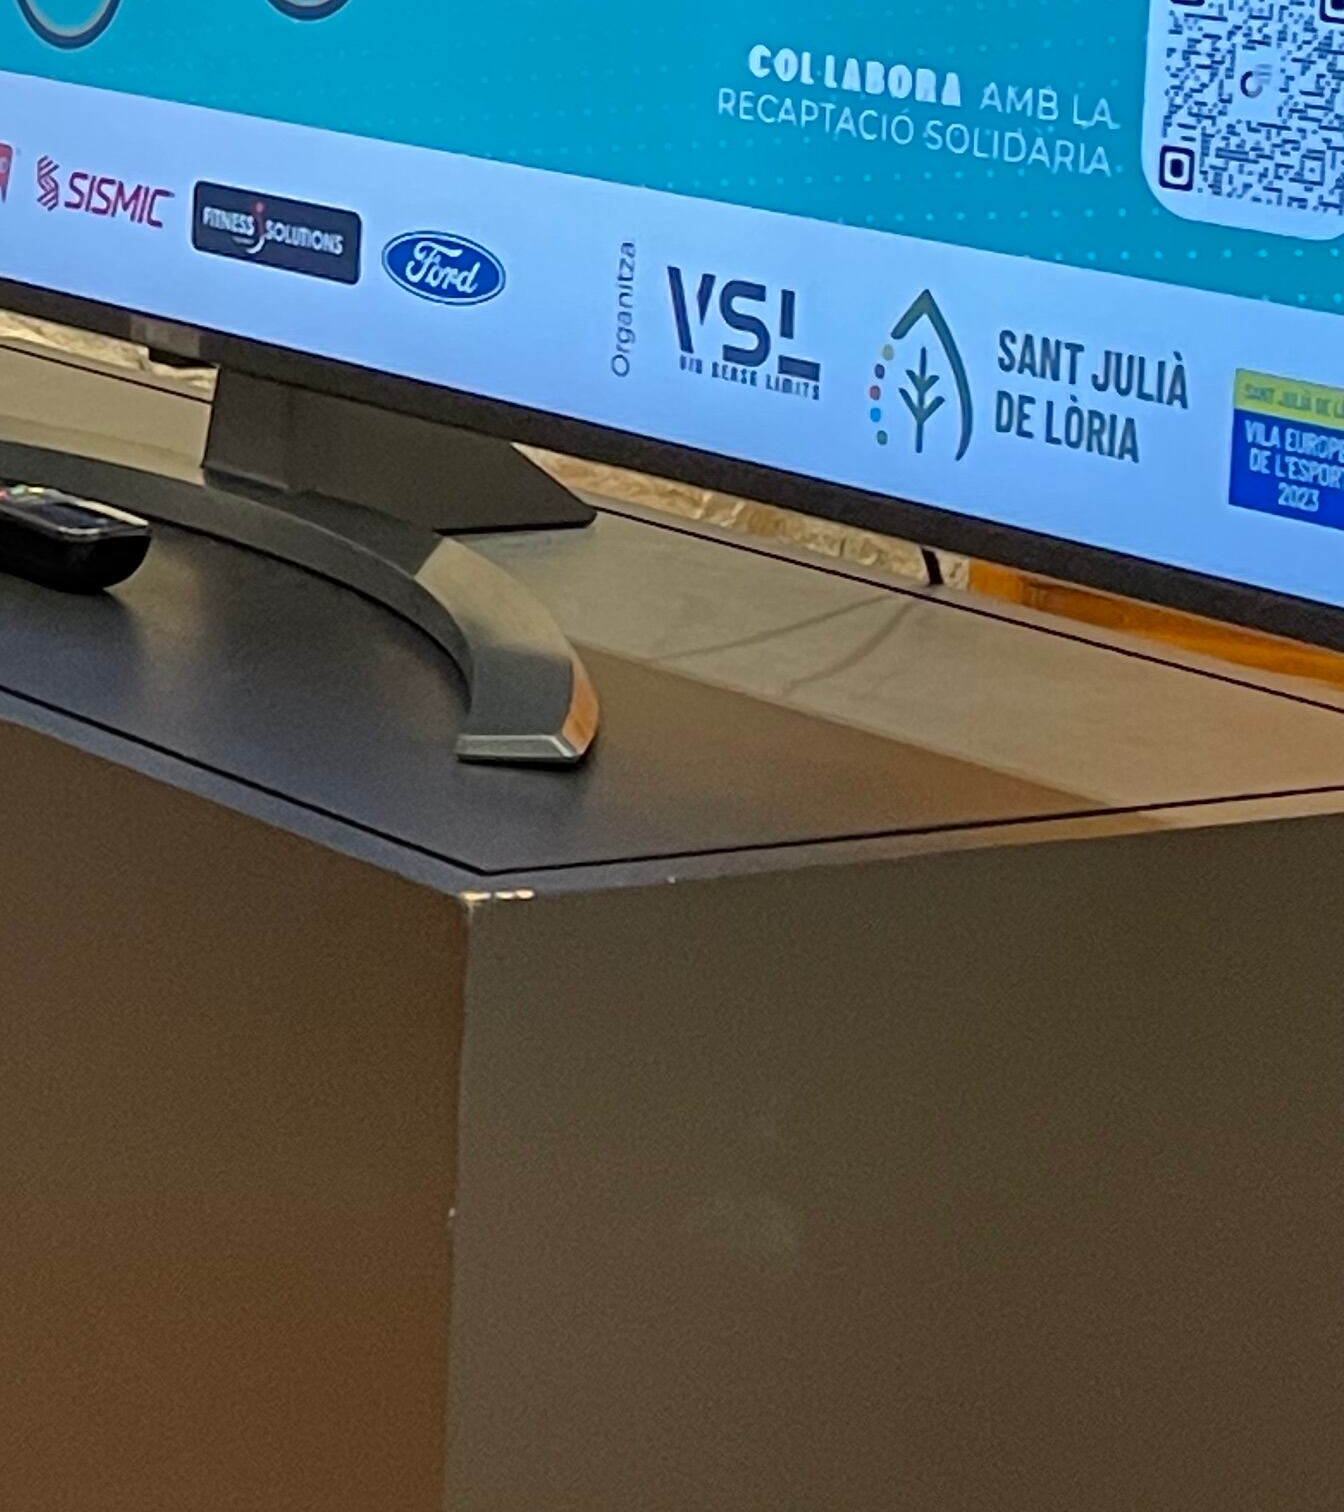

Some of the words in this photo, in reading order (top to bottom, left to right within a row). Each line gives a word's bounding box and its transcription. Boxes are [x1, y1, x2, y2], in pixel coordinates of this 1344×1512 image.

[717, 87, 914, 146] RECAPTACIÓ
[979, 81, 1059, 121] AMB
[1072, 92, 1119, 130] LA
[64, 171, 175, 229] SISMIC
[202, 206, 255, 237] FITNESS
[265, 220, 344, 256] SOLUTIONS
[405, 240, 481, 294] Ford
[611, 241, 636, 378] Organitza
[667, 265, 822, 382] VSL
[997, 328, 1085, 386] SANT
[1091, 350, 1189, 410] JULIÀ
[994, 389, 1037, 440] DE
[1045, 394, 1141, 464] LÒRIA
[1244, 419, 1282, 449] VILA
[1248, 447, 1272, 475] DE
[1277, 481, 1321, 513] 2023
